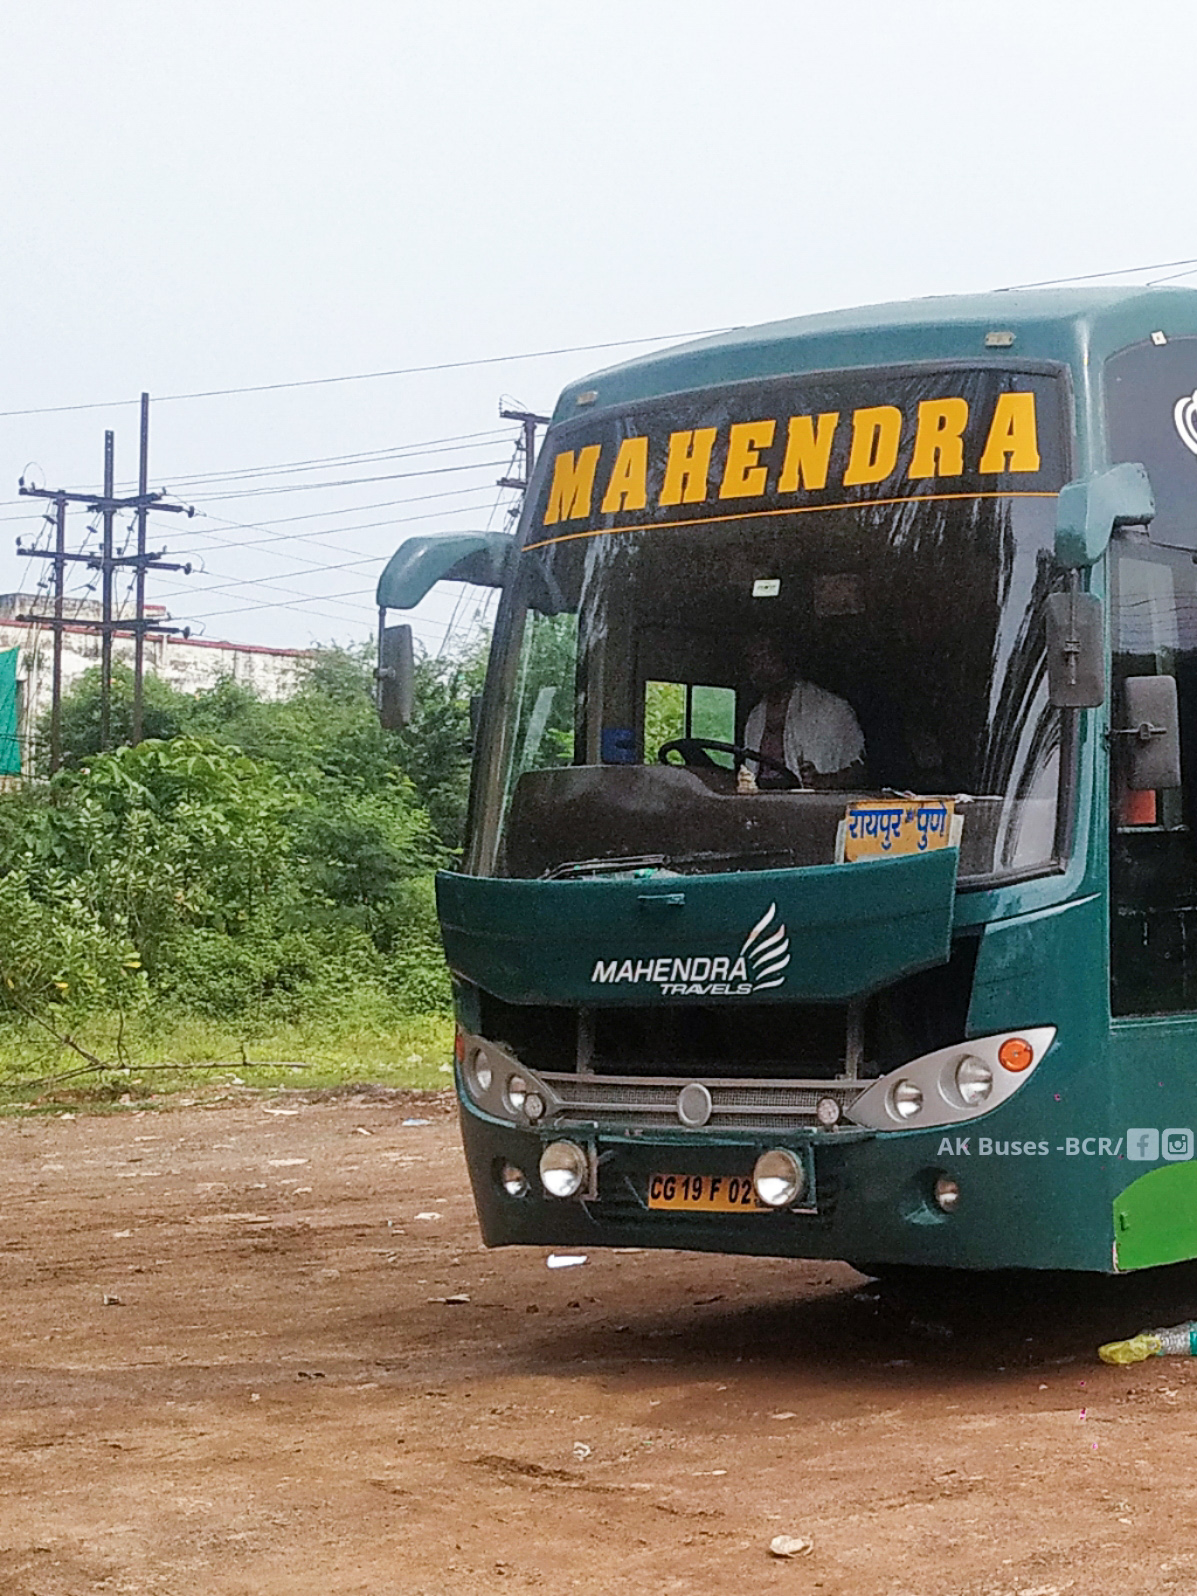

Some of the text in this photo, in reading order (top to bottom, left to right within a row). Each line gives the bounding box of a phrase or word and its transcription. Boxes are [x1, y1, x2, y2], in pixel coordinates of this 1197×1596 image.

[543, 392, 1041, 526] MAHENDRA
[849, 809, 904, 850] रायपुर
[591, 957, 748, 983] MAHENDRA
[660, 983, 753, 996] TRAVELS
[651, 1176, 759, 1205] CG 19 F 02
